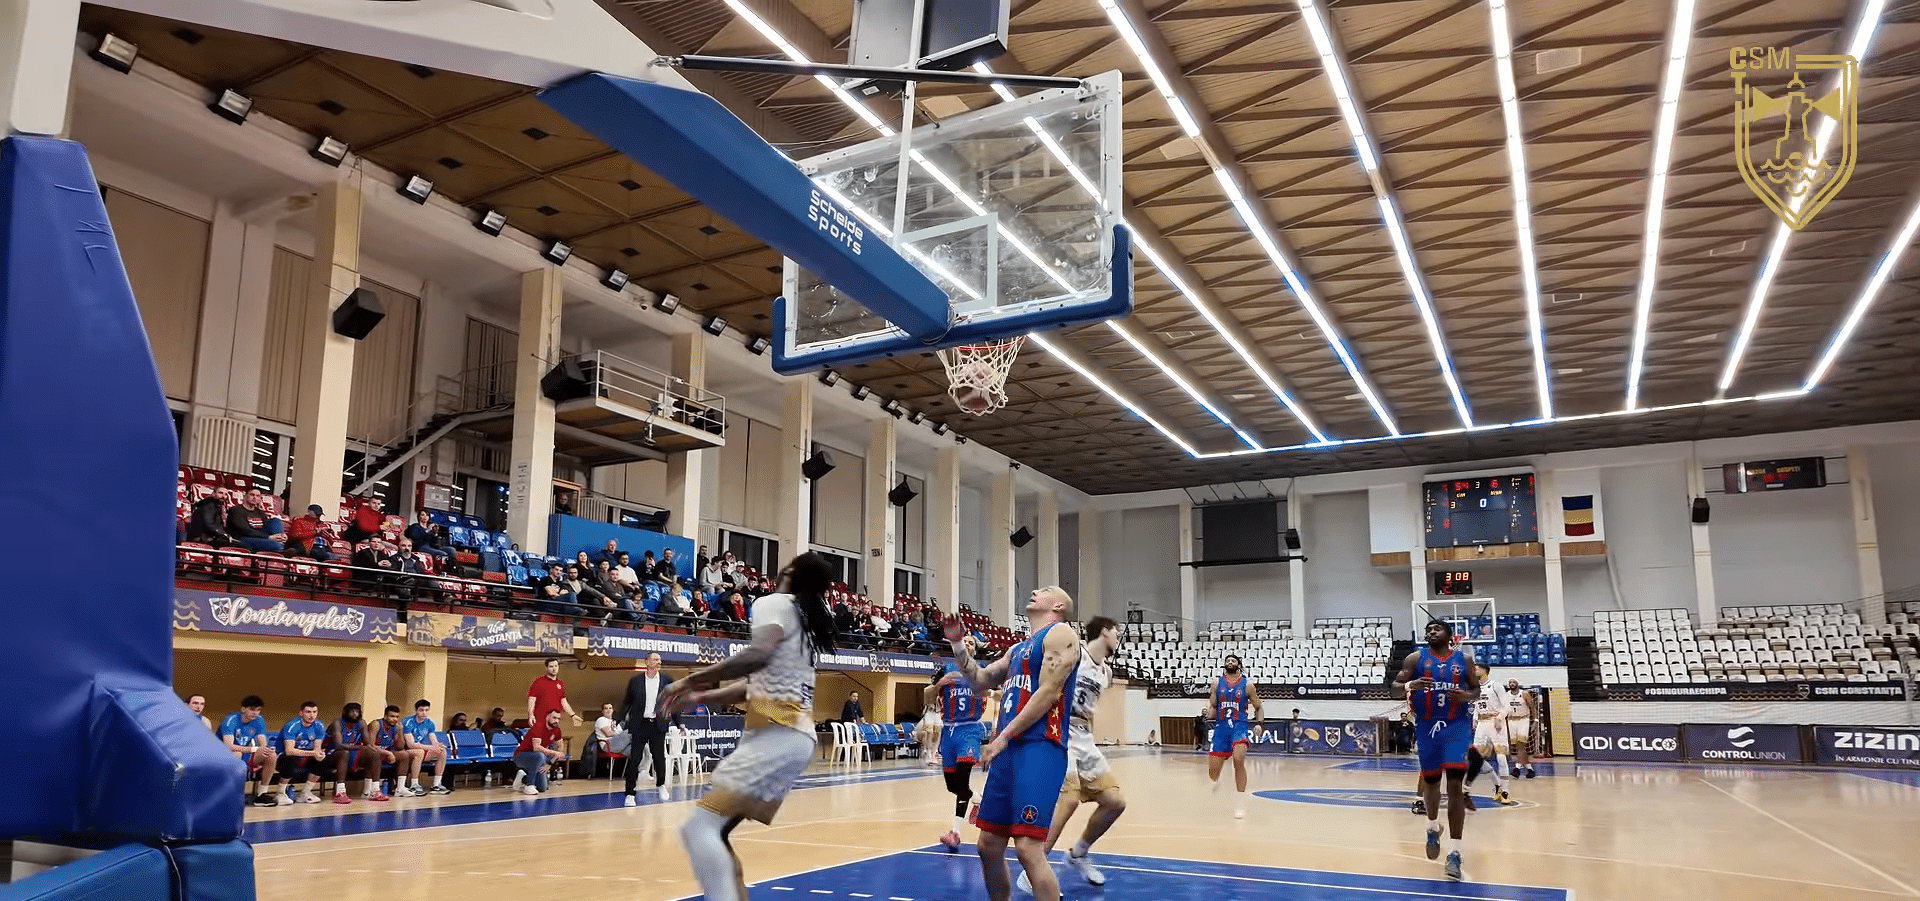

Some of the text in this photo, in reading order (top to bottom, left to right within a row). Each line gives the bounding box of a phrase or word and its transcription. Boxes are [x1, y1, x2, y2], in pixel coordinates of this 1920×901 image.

[810, 189, 864, 241] Schelde
[807, 204, 862, 256] Sports
[228, 596, 348, 637] Constangeles
[603, 635, 700, 656] #TEAMISEVERYTHING
[1437, 693, 1446, 707] 3
[1814, 687, 1839, 695] CSM
[958, 697, 966, 712] 5
[1003, 692, 1014, 714] 4
[1226, 708, 1232, 718] 2
[1886, 757, 1900, 765] CU
